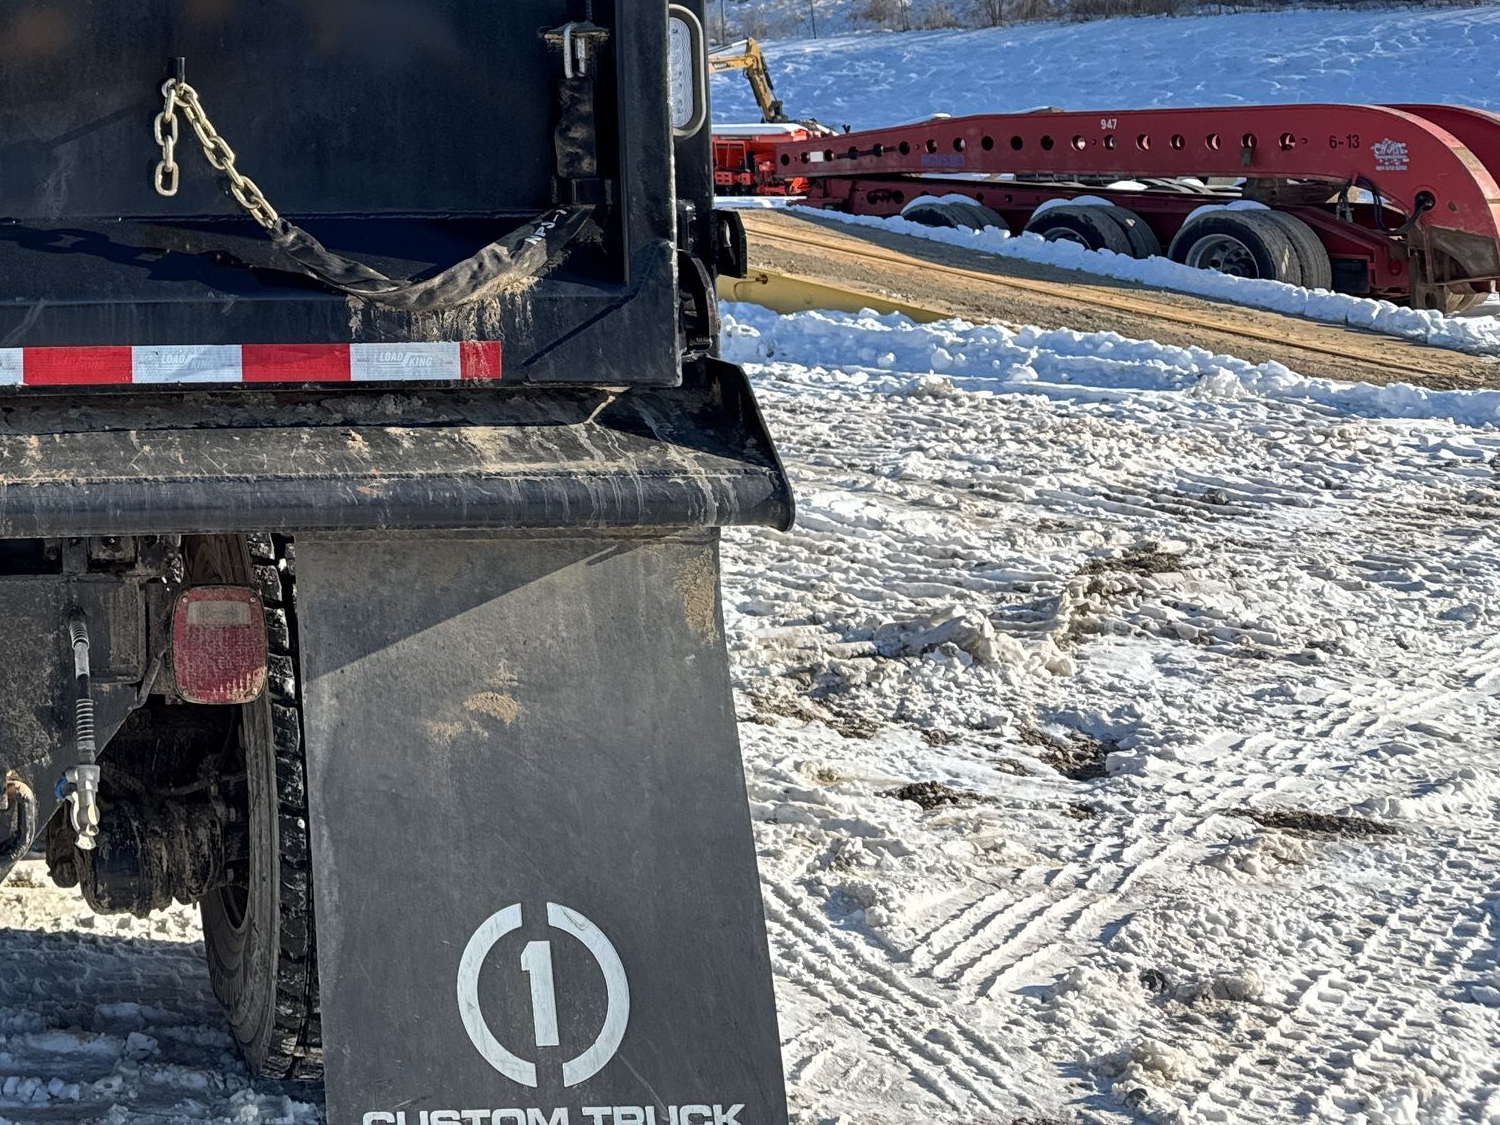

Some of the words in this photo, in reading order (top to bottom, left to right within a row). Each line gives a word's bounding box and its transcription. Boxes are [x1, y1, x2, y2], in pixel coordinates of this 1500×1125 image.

[1100, 118, 1117, 130] 947
[1329, 134, 1360, 149] 6-13
[581, 1104, 745, 1125] TRUCK
